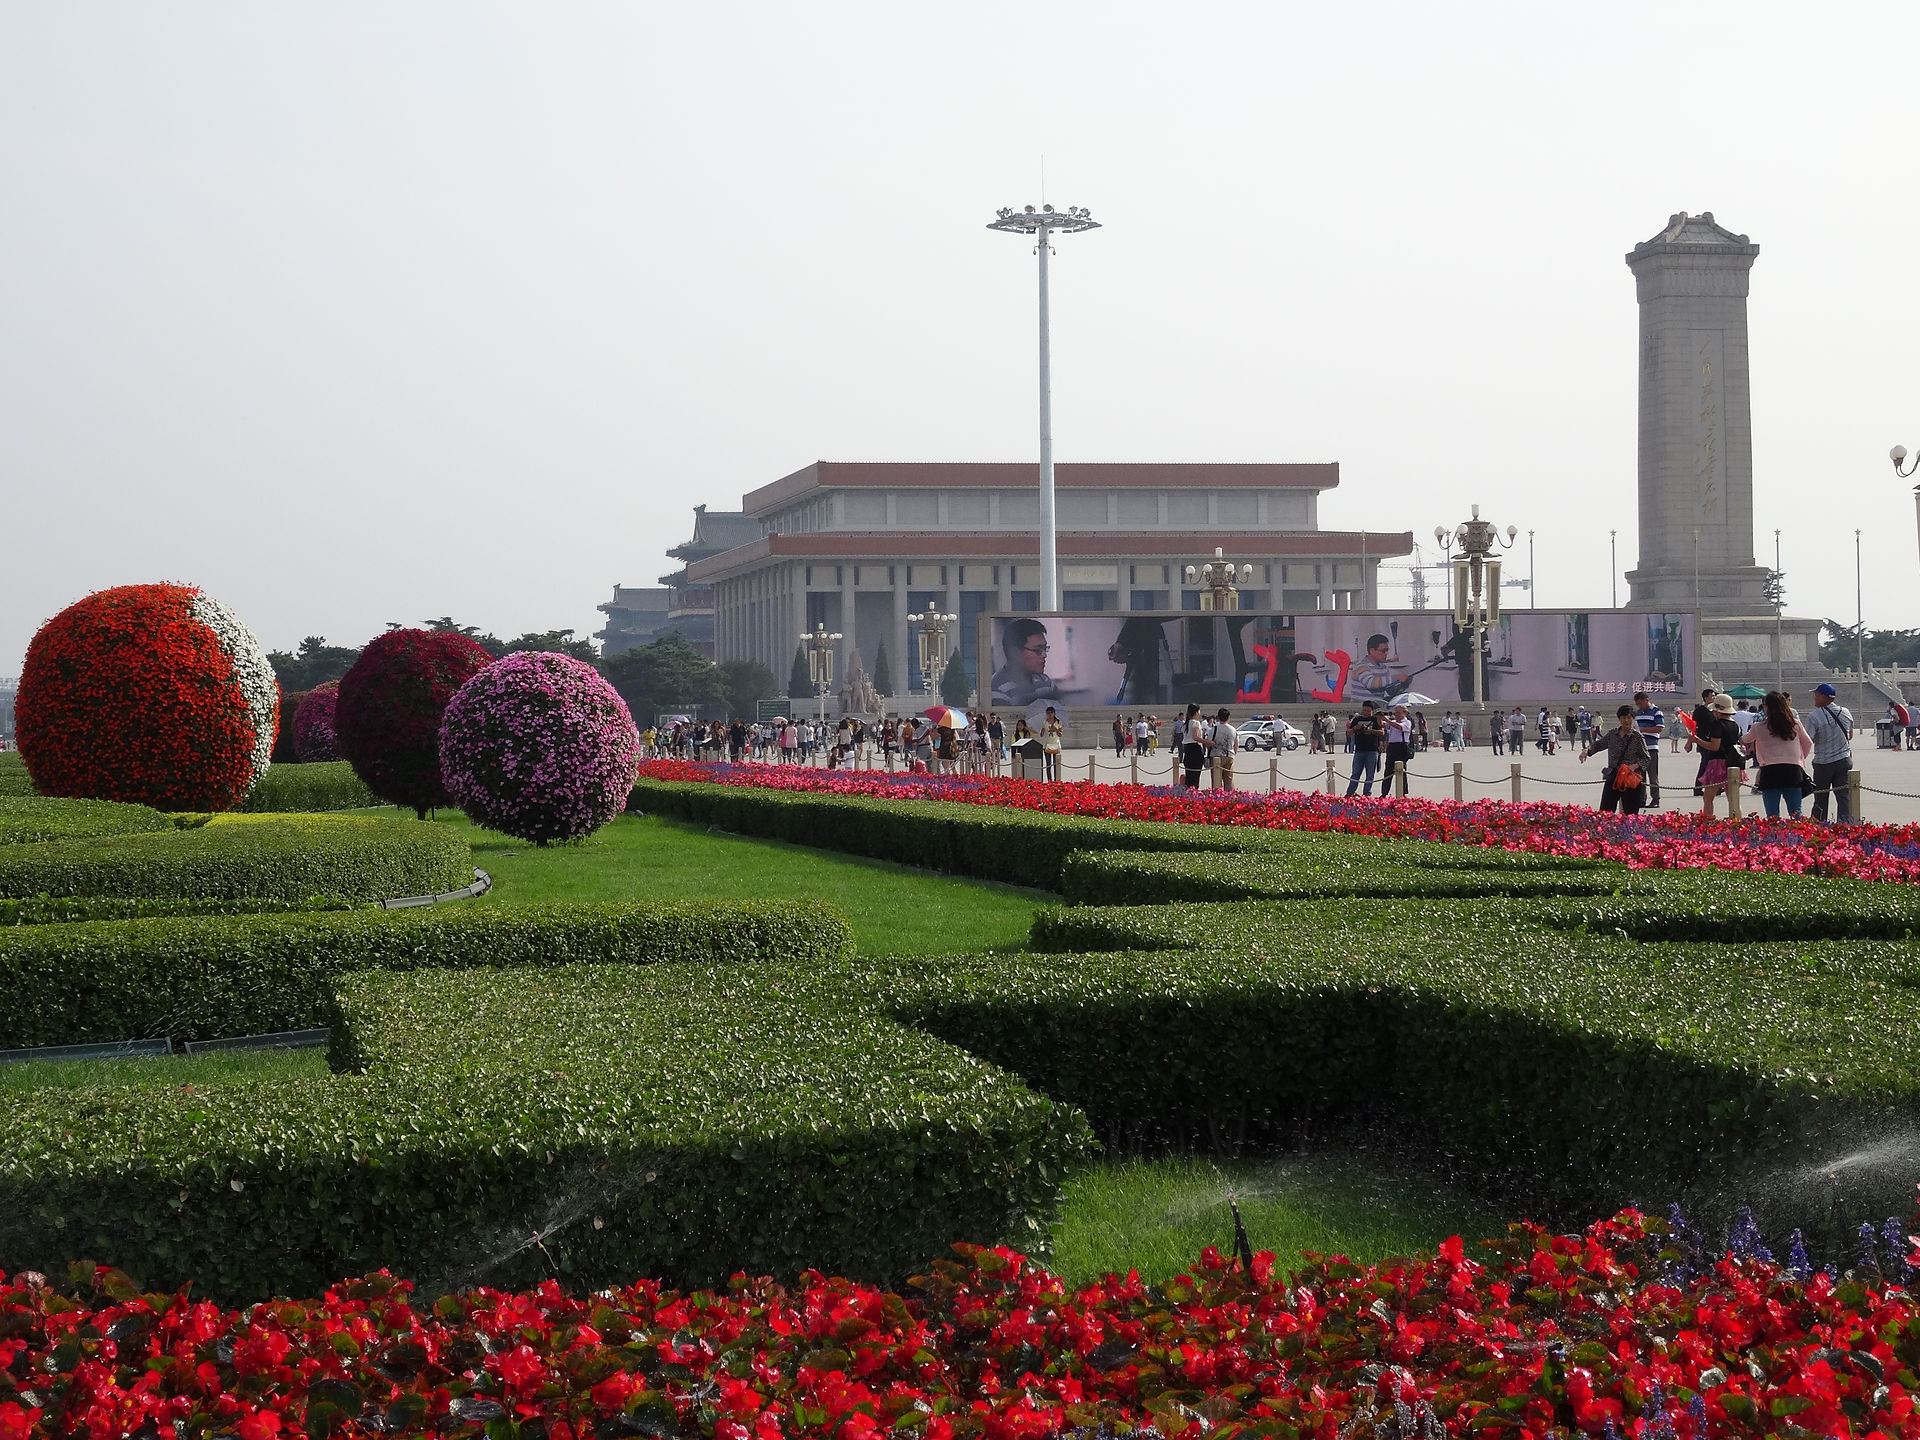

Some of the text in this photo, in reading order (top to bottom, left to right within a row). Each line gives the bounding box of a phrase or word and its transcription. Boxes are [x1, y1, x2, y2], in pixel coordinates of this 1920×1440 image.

[1583, 681, 1676, 693] 康复服务 促进共融
